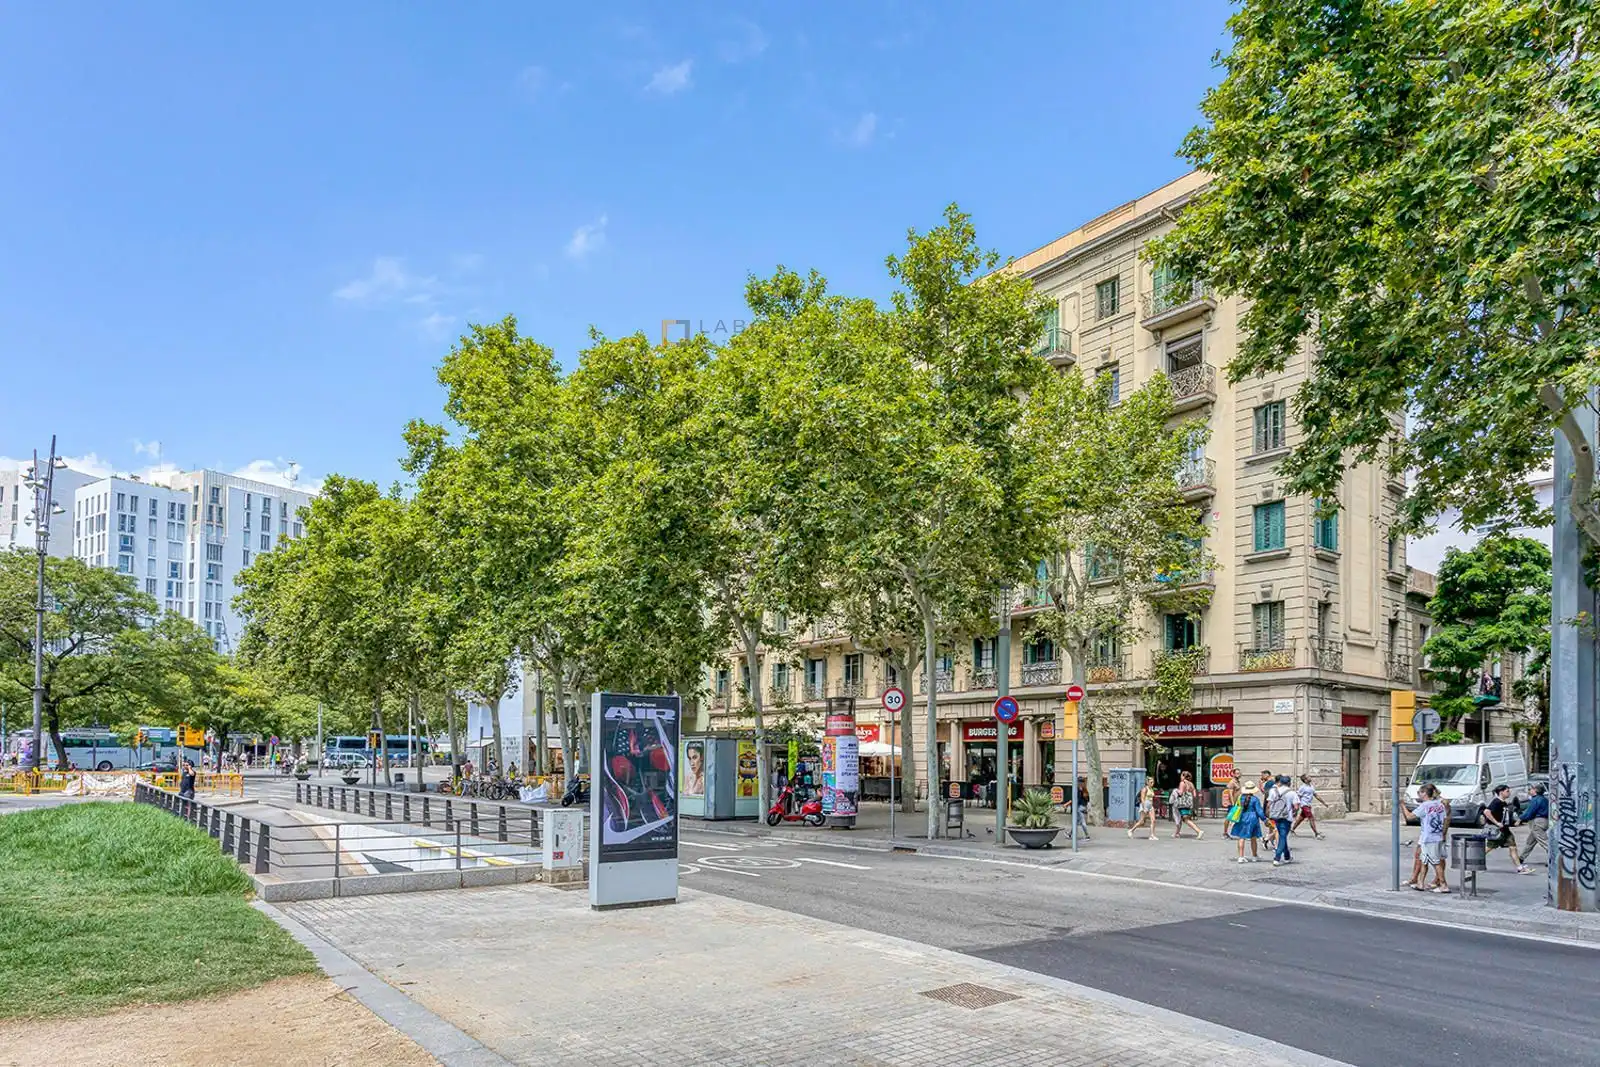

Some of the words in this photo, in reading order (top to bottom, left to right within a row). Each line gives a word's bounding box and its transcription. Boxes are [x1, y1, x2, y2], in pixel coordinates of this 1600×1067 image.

[887, 695, 901, 704] 30
[604, 706, 676, 721] AIR
[1210, 723, 1226, 731] 1954
[968, 728, 997, 737] BURGER
